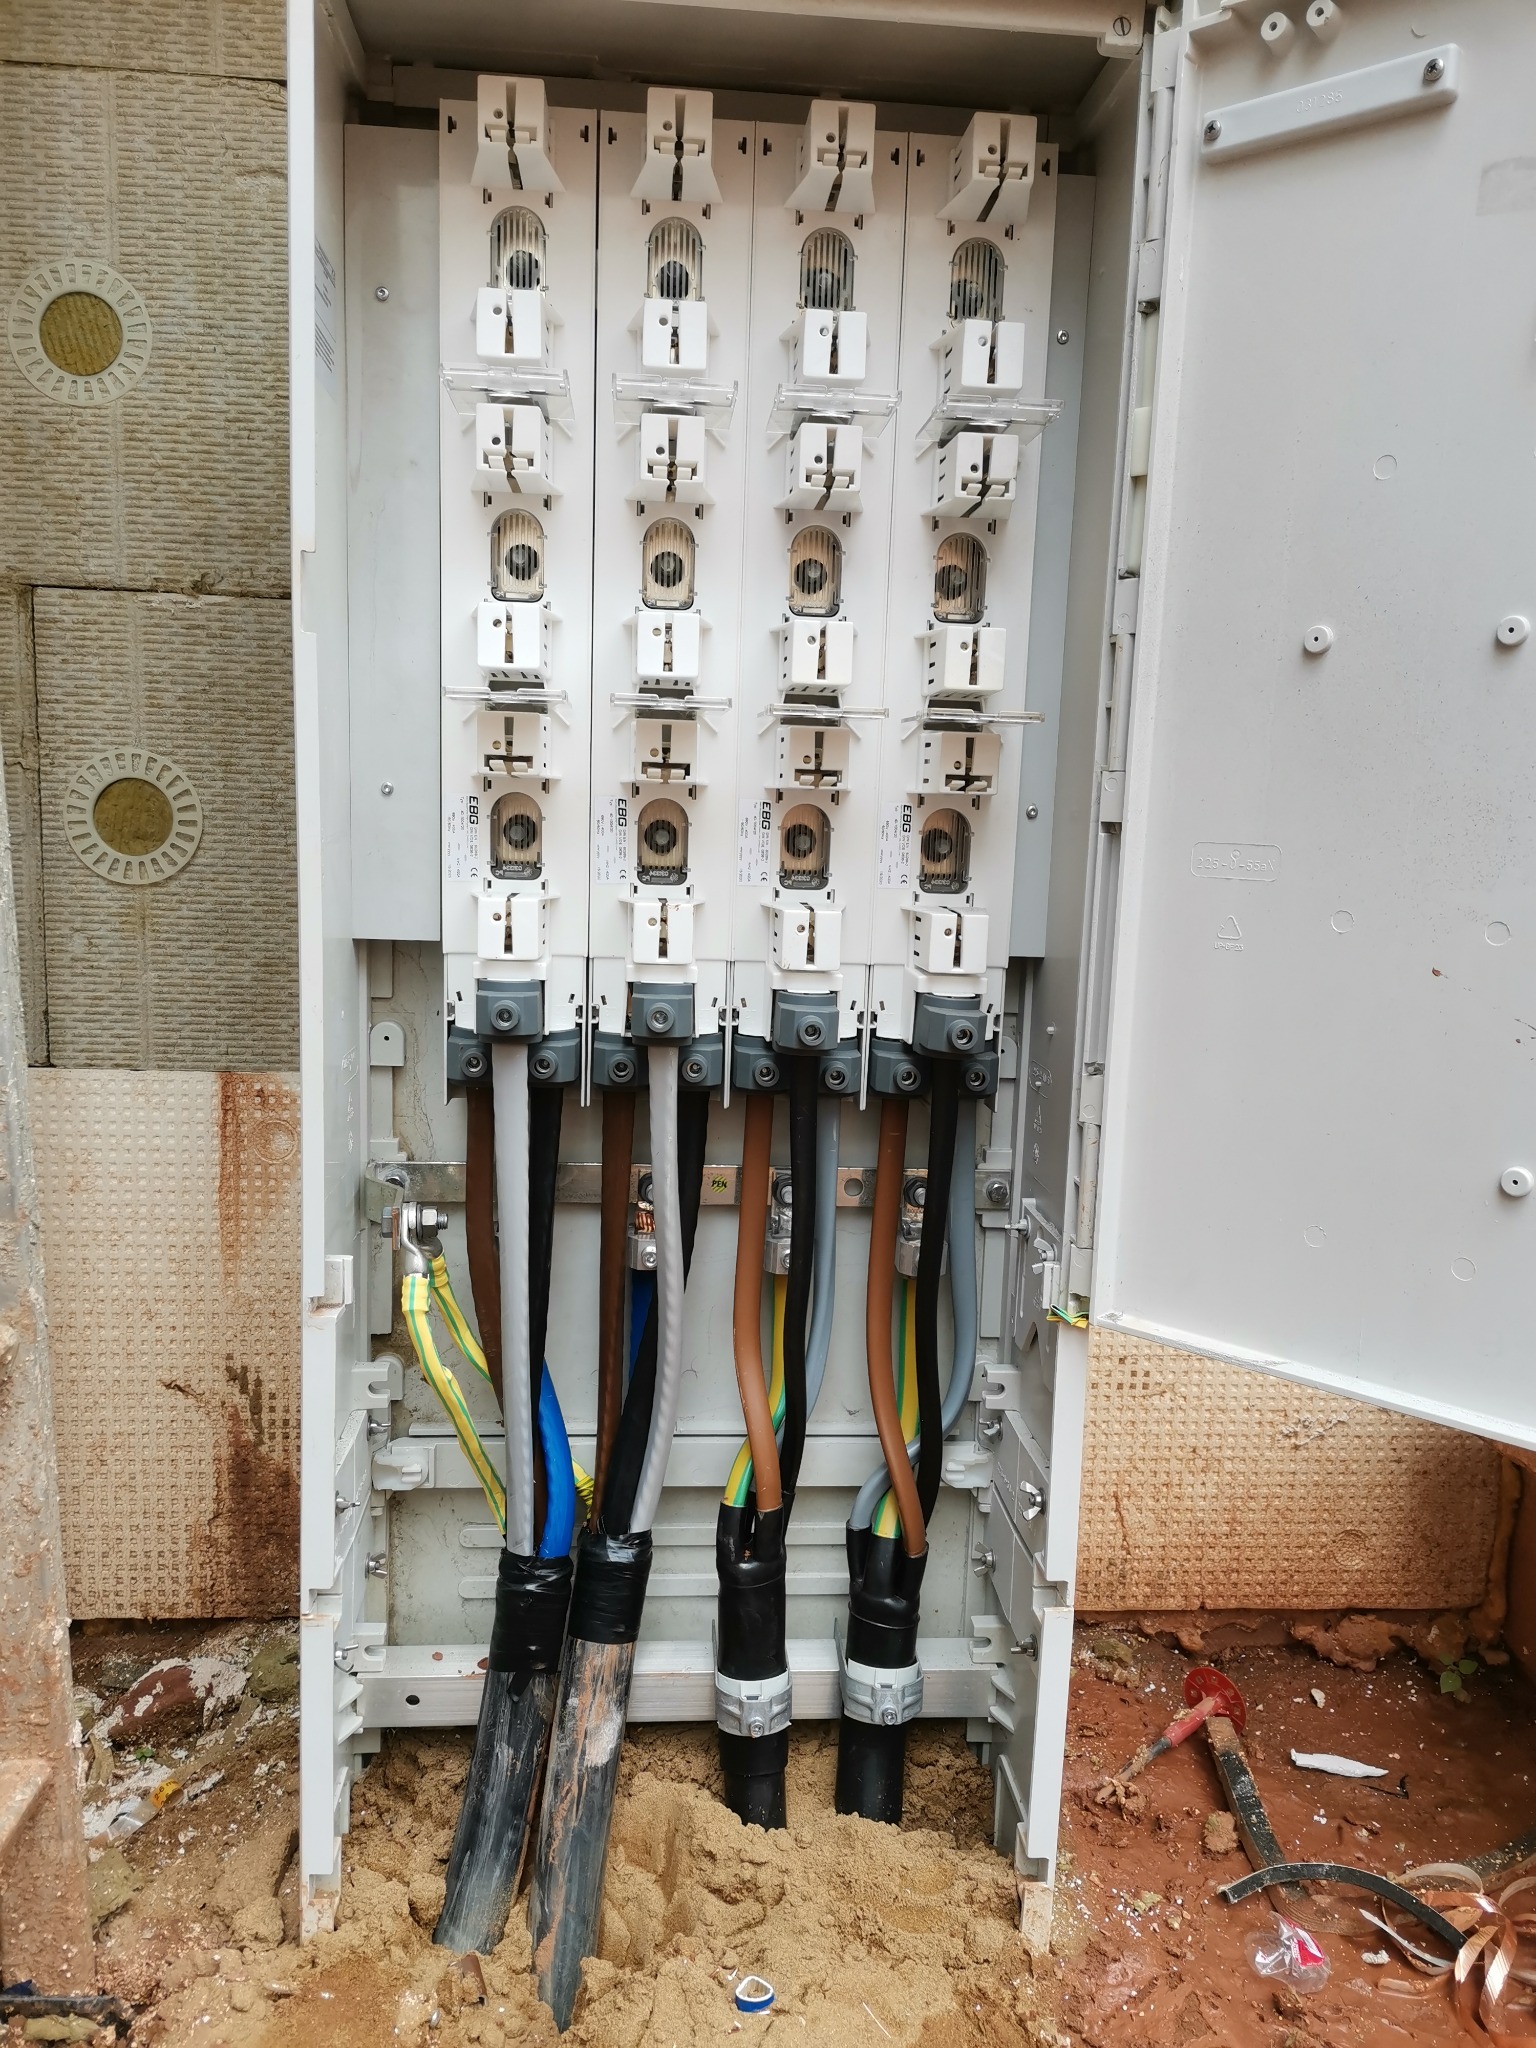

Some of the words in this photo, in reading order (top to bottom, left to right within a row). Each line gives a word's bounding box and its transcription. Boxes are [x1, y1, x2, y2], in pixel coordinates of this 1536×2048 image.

[469, 795, 479, 825] EBG
[618, 798, 627, 827] EBG
[761, 801, 771, 830] EBG
[902, 804, 912, 833] EBG
[711, 1180, 728, 1188] PEN
